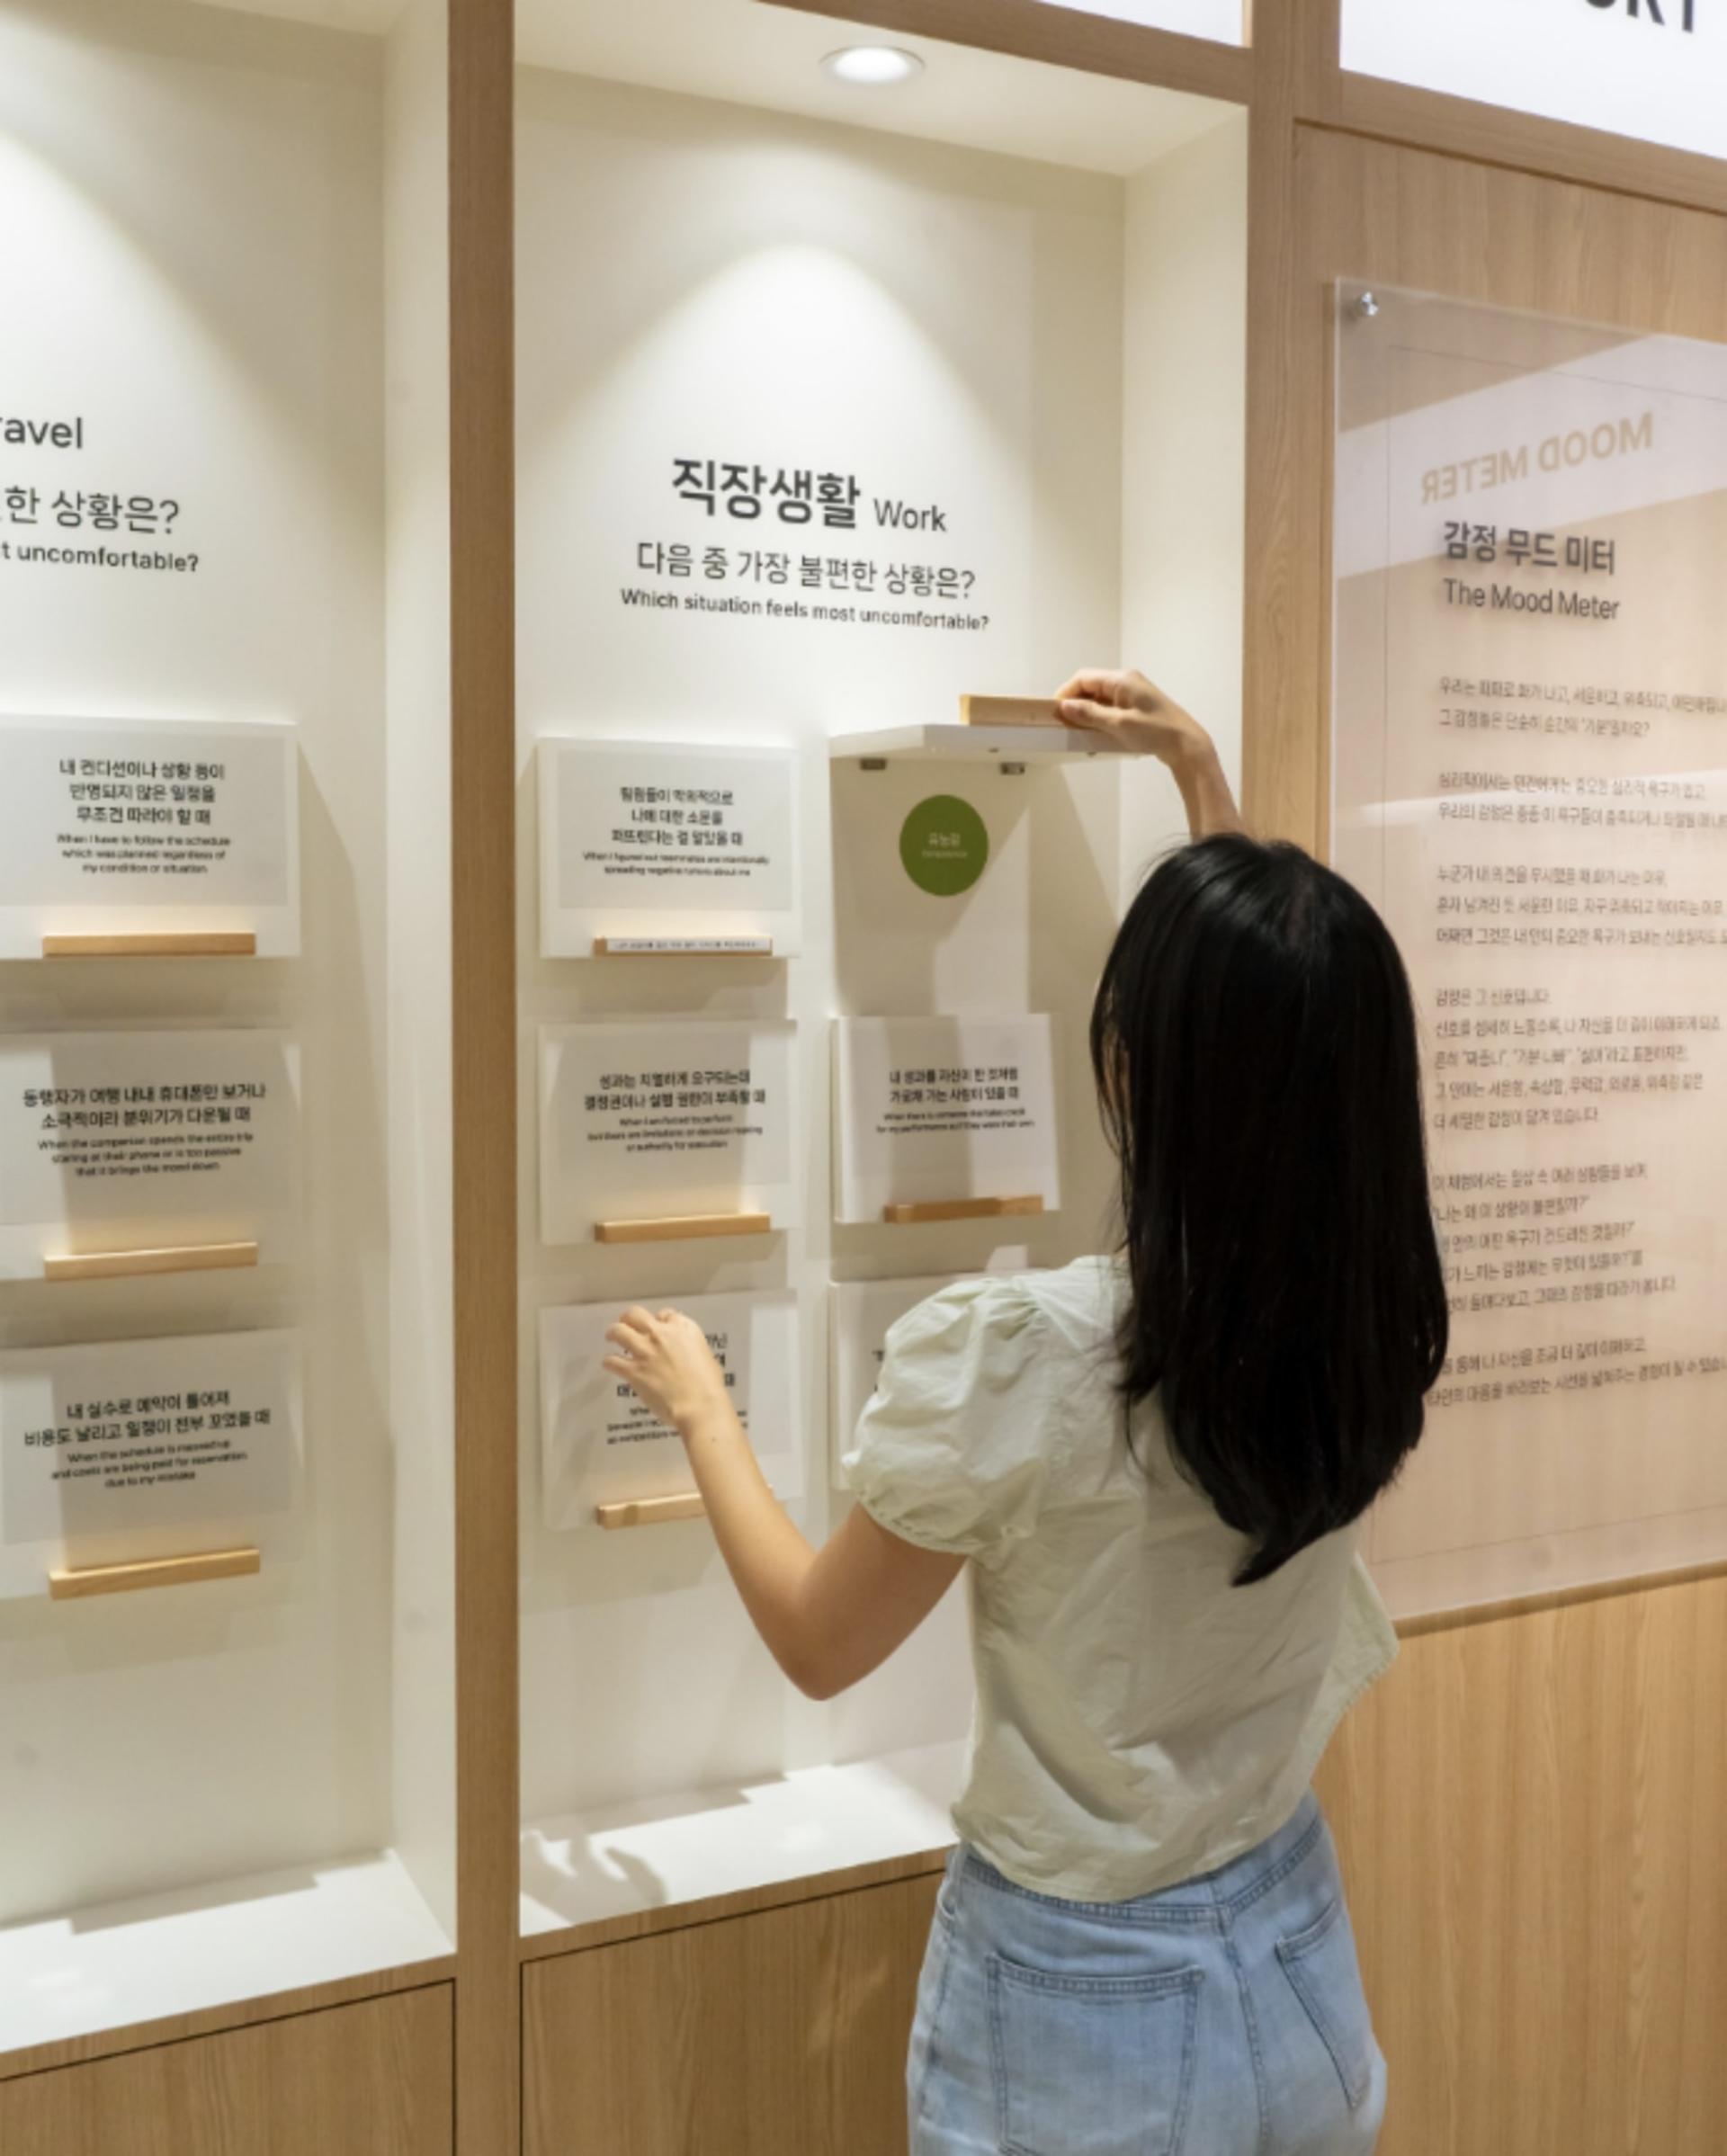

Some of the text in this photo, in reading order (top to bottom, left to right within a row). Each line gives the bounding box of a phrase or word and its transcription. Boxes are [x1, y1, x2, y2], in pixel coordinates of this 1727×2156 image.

[0, 416, 82, 449] avel
[0, 486, 180, 534] 한 상황은?
[672, 458, 947, 532] 직장생활 Work
[17, 545, 199, 572] uncomfortable?
[1444, 521, 1615, 576] 감정 무드 미터
[637, 541, 976, 600] 다음 중 가장 불편한 상황은?
[621, 588, 989, 631] Which situation feels most uncomfortable?
[1443, 577, 1620, 620] The Mood Meter
[59, 760, 76, 775] 내
